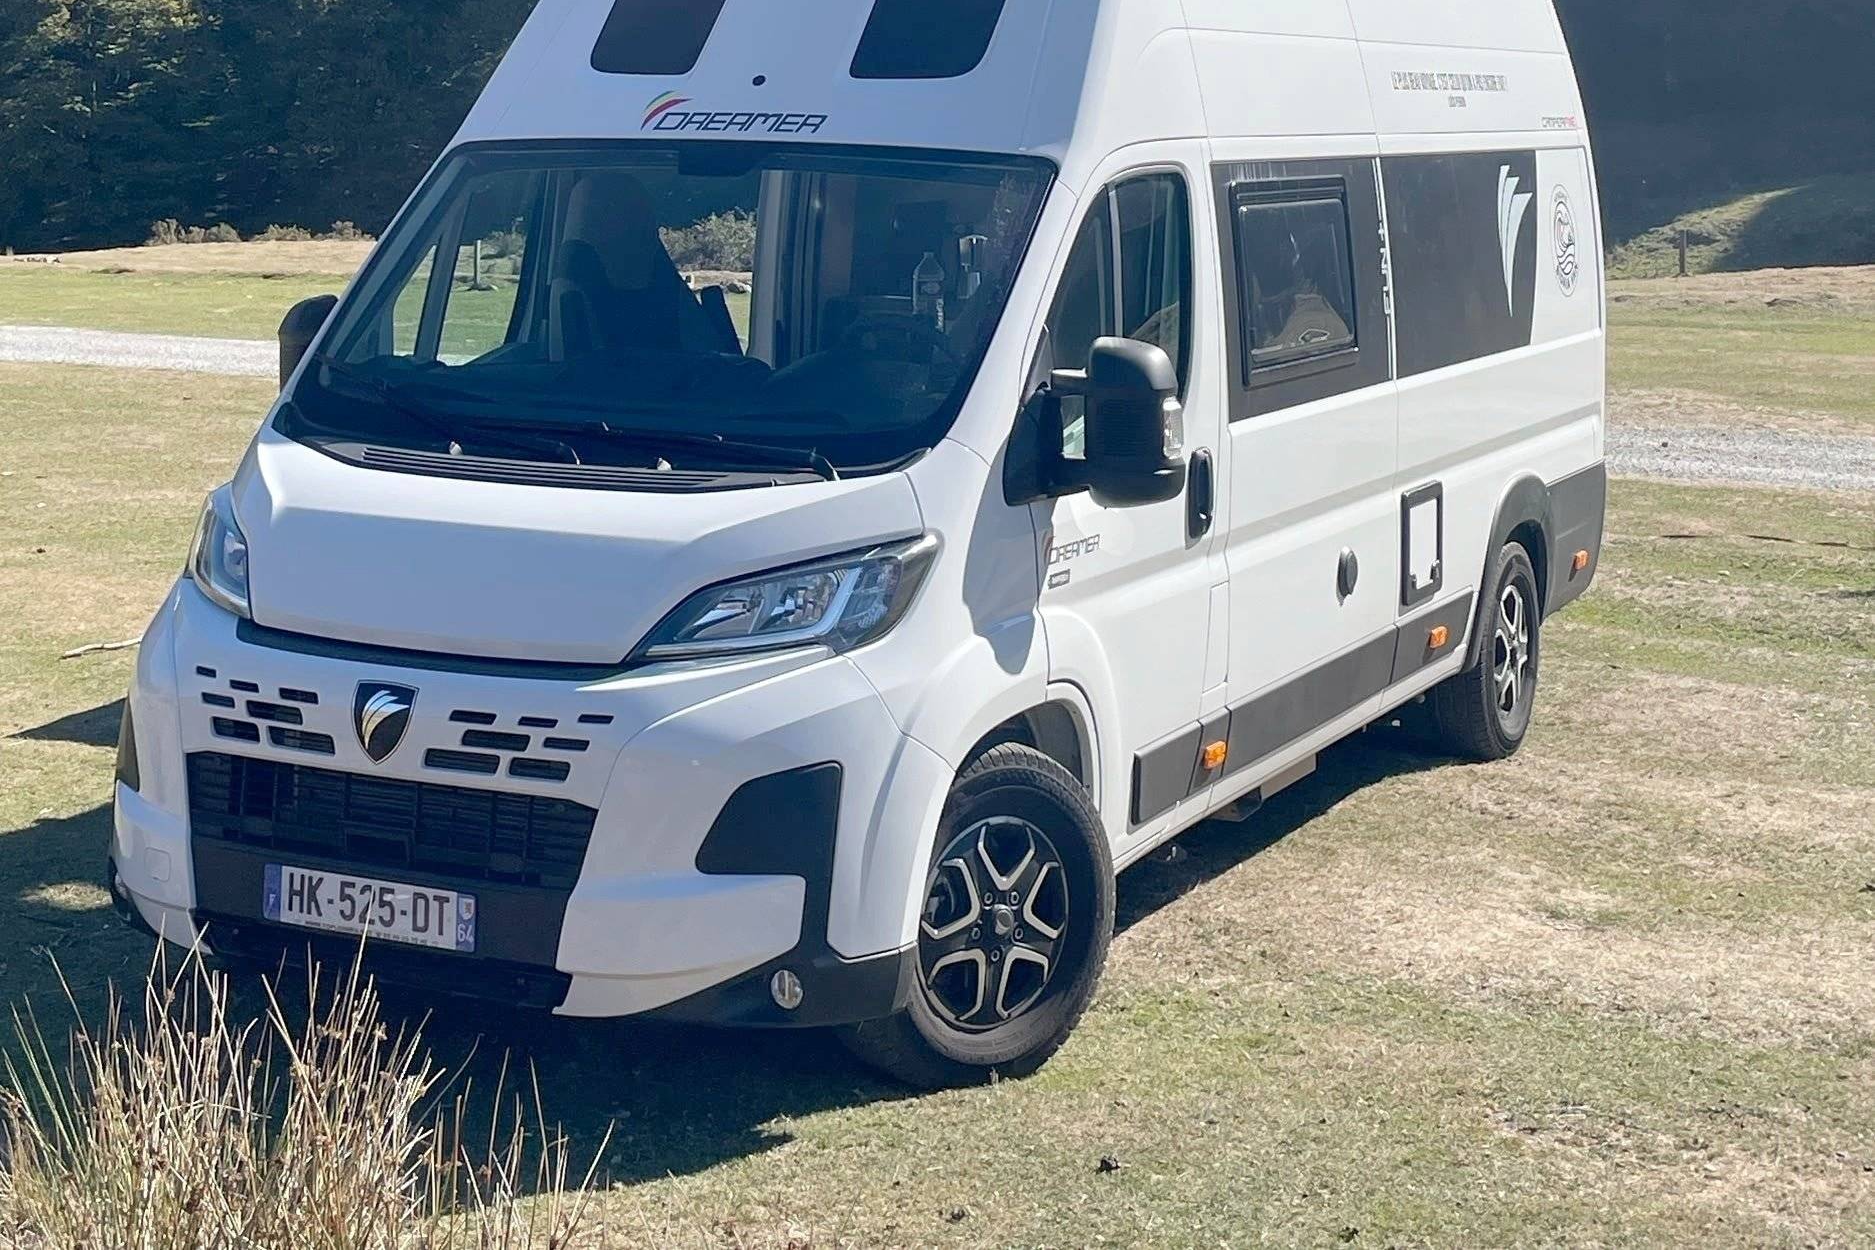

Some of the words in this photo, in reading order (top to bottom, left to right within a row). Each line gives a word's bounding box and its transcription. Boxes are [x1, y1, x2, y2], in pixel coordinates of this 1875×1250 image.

[652, 112, 829, 134] DREAMER
[1048, 533, 1101, 565] DREAMER
[287, 872, 450, 936] HK-525-DT
[457, 923, 475, 943] 64
